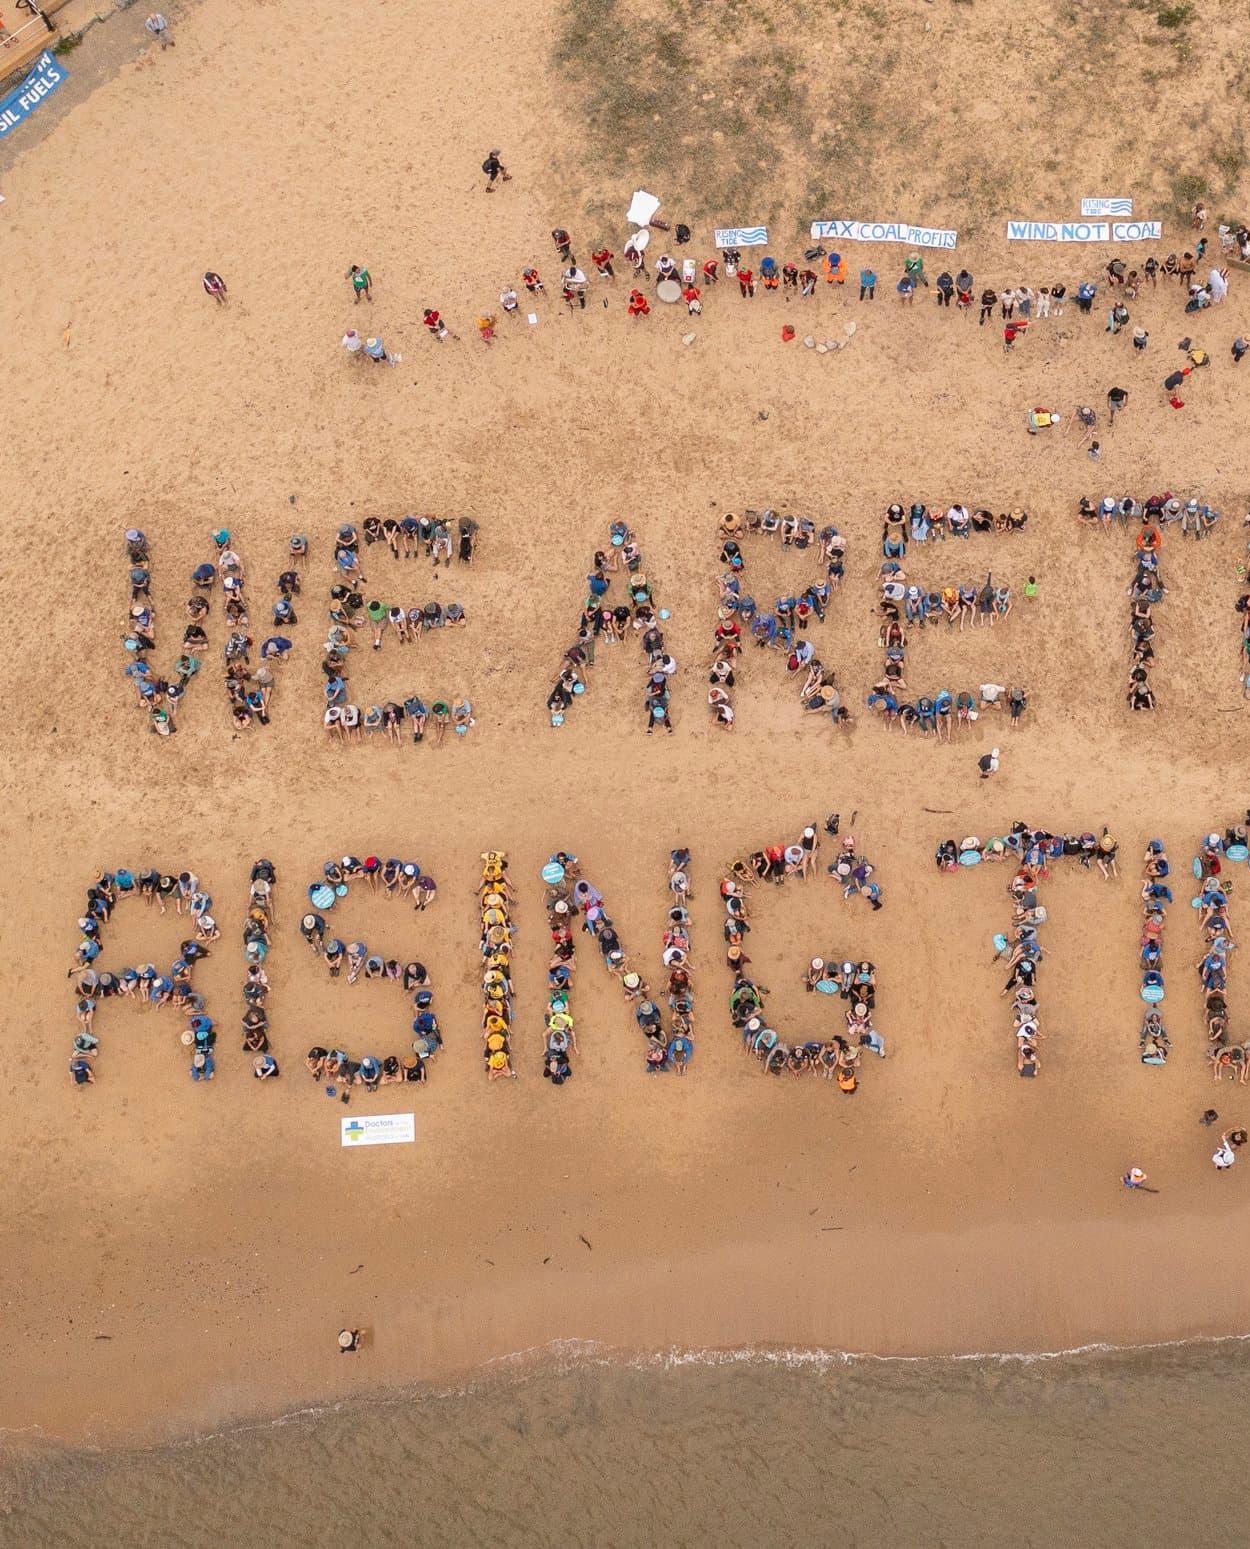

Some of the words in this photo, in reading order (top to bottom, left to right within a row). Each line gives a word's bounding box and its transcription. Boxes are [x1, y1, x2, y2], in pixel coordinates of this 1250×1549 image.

[19, 67, 60, 111] FUELS
[816, 221, 856, 238] TAX
[859, 223, 908, 240] COAL
[908, 228, 956, 248] PROFITS
[1010, 222, 1058, 239] WIND
[1061, 224, 1106, 241] NOT
[1114, 222, 1160, 240] COAL
